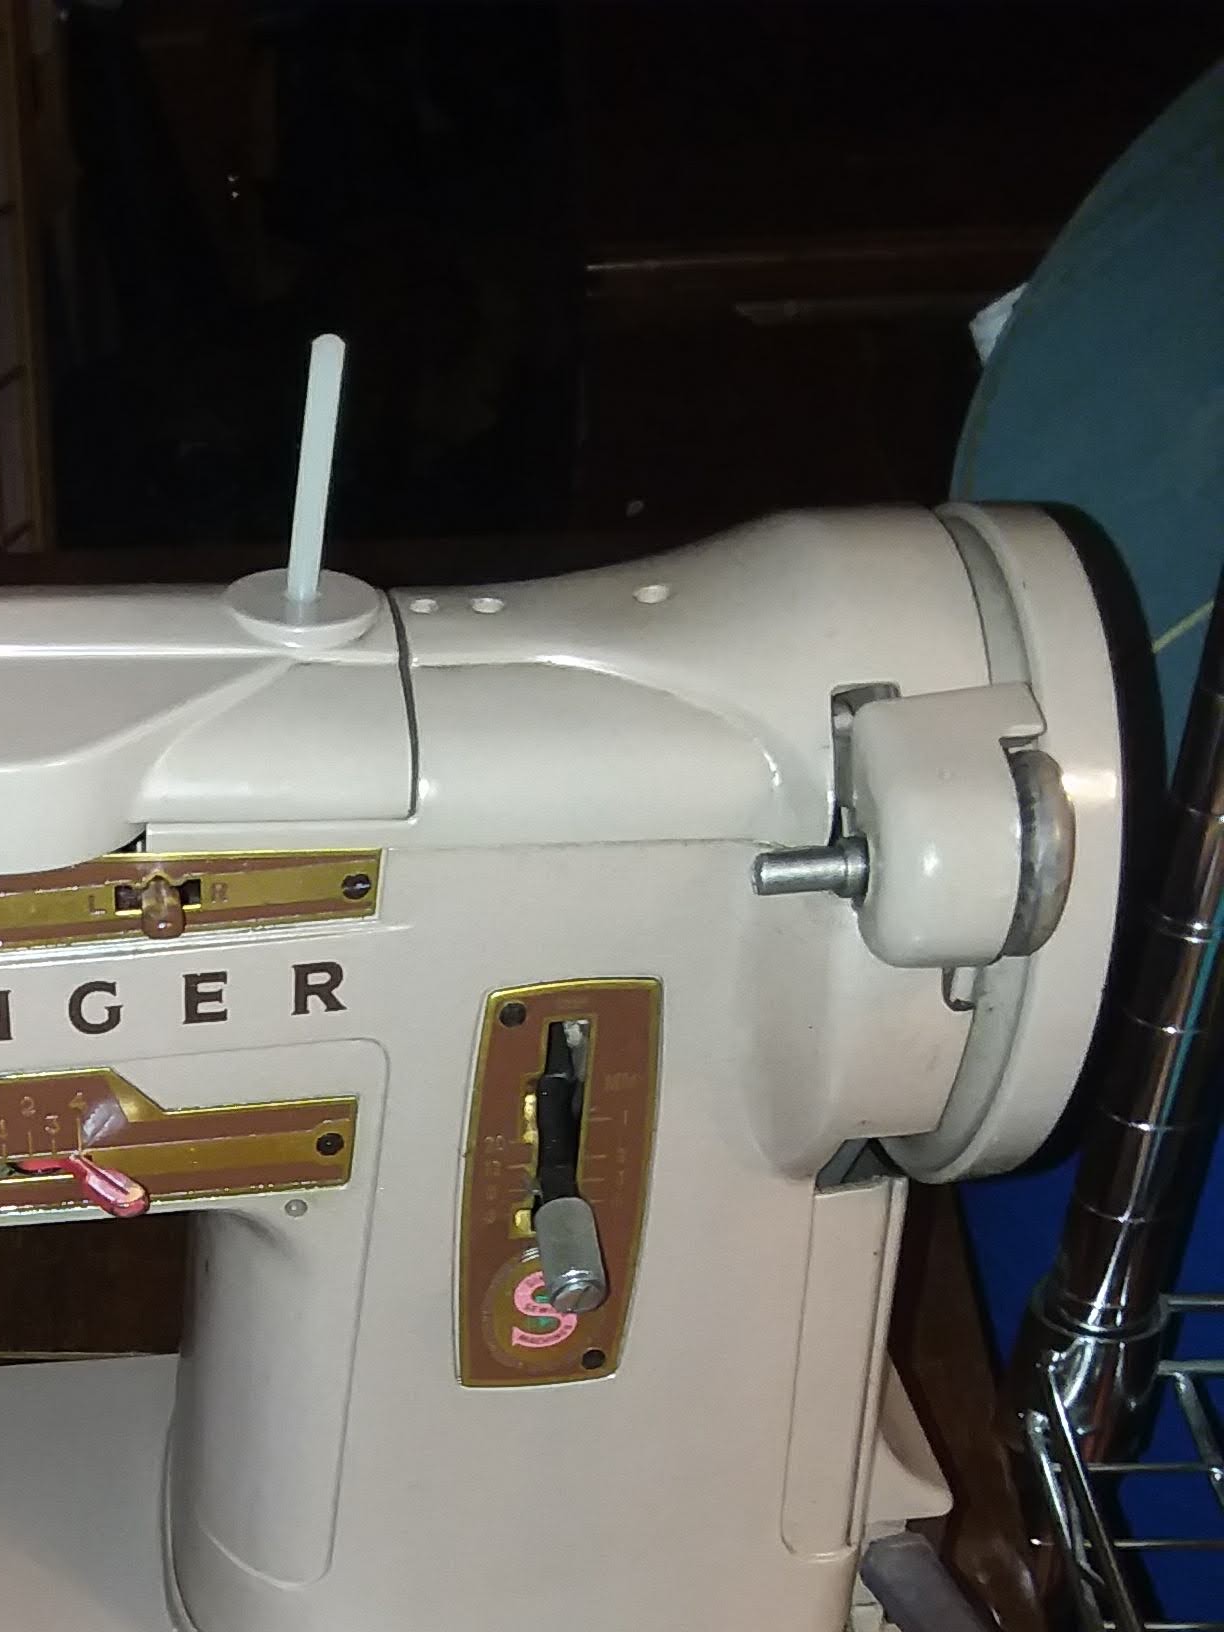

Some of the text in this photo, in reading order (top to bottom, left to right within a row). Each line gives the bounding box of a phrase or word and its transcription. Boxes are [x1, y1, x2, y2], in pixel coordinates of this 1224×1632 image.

[210, 881, 229, 905] R
[88, 894, 107, 915] L
[20, 1095, 36, 1115] 2
[44, 1114, 60, 1135] 3
